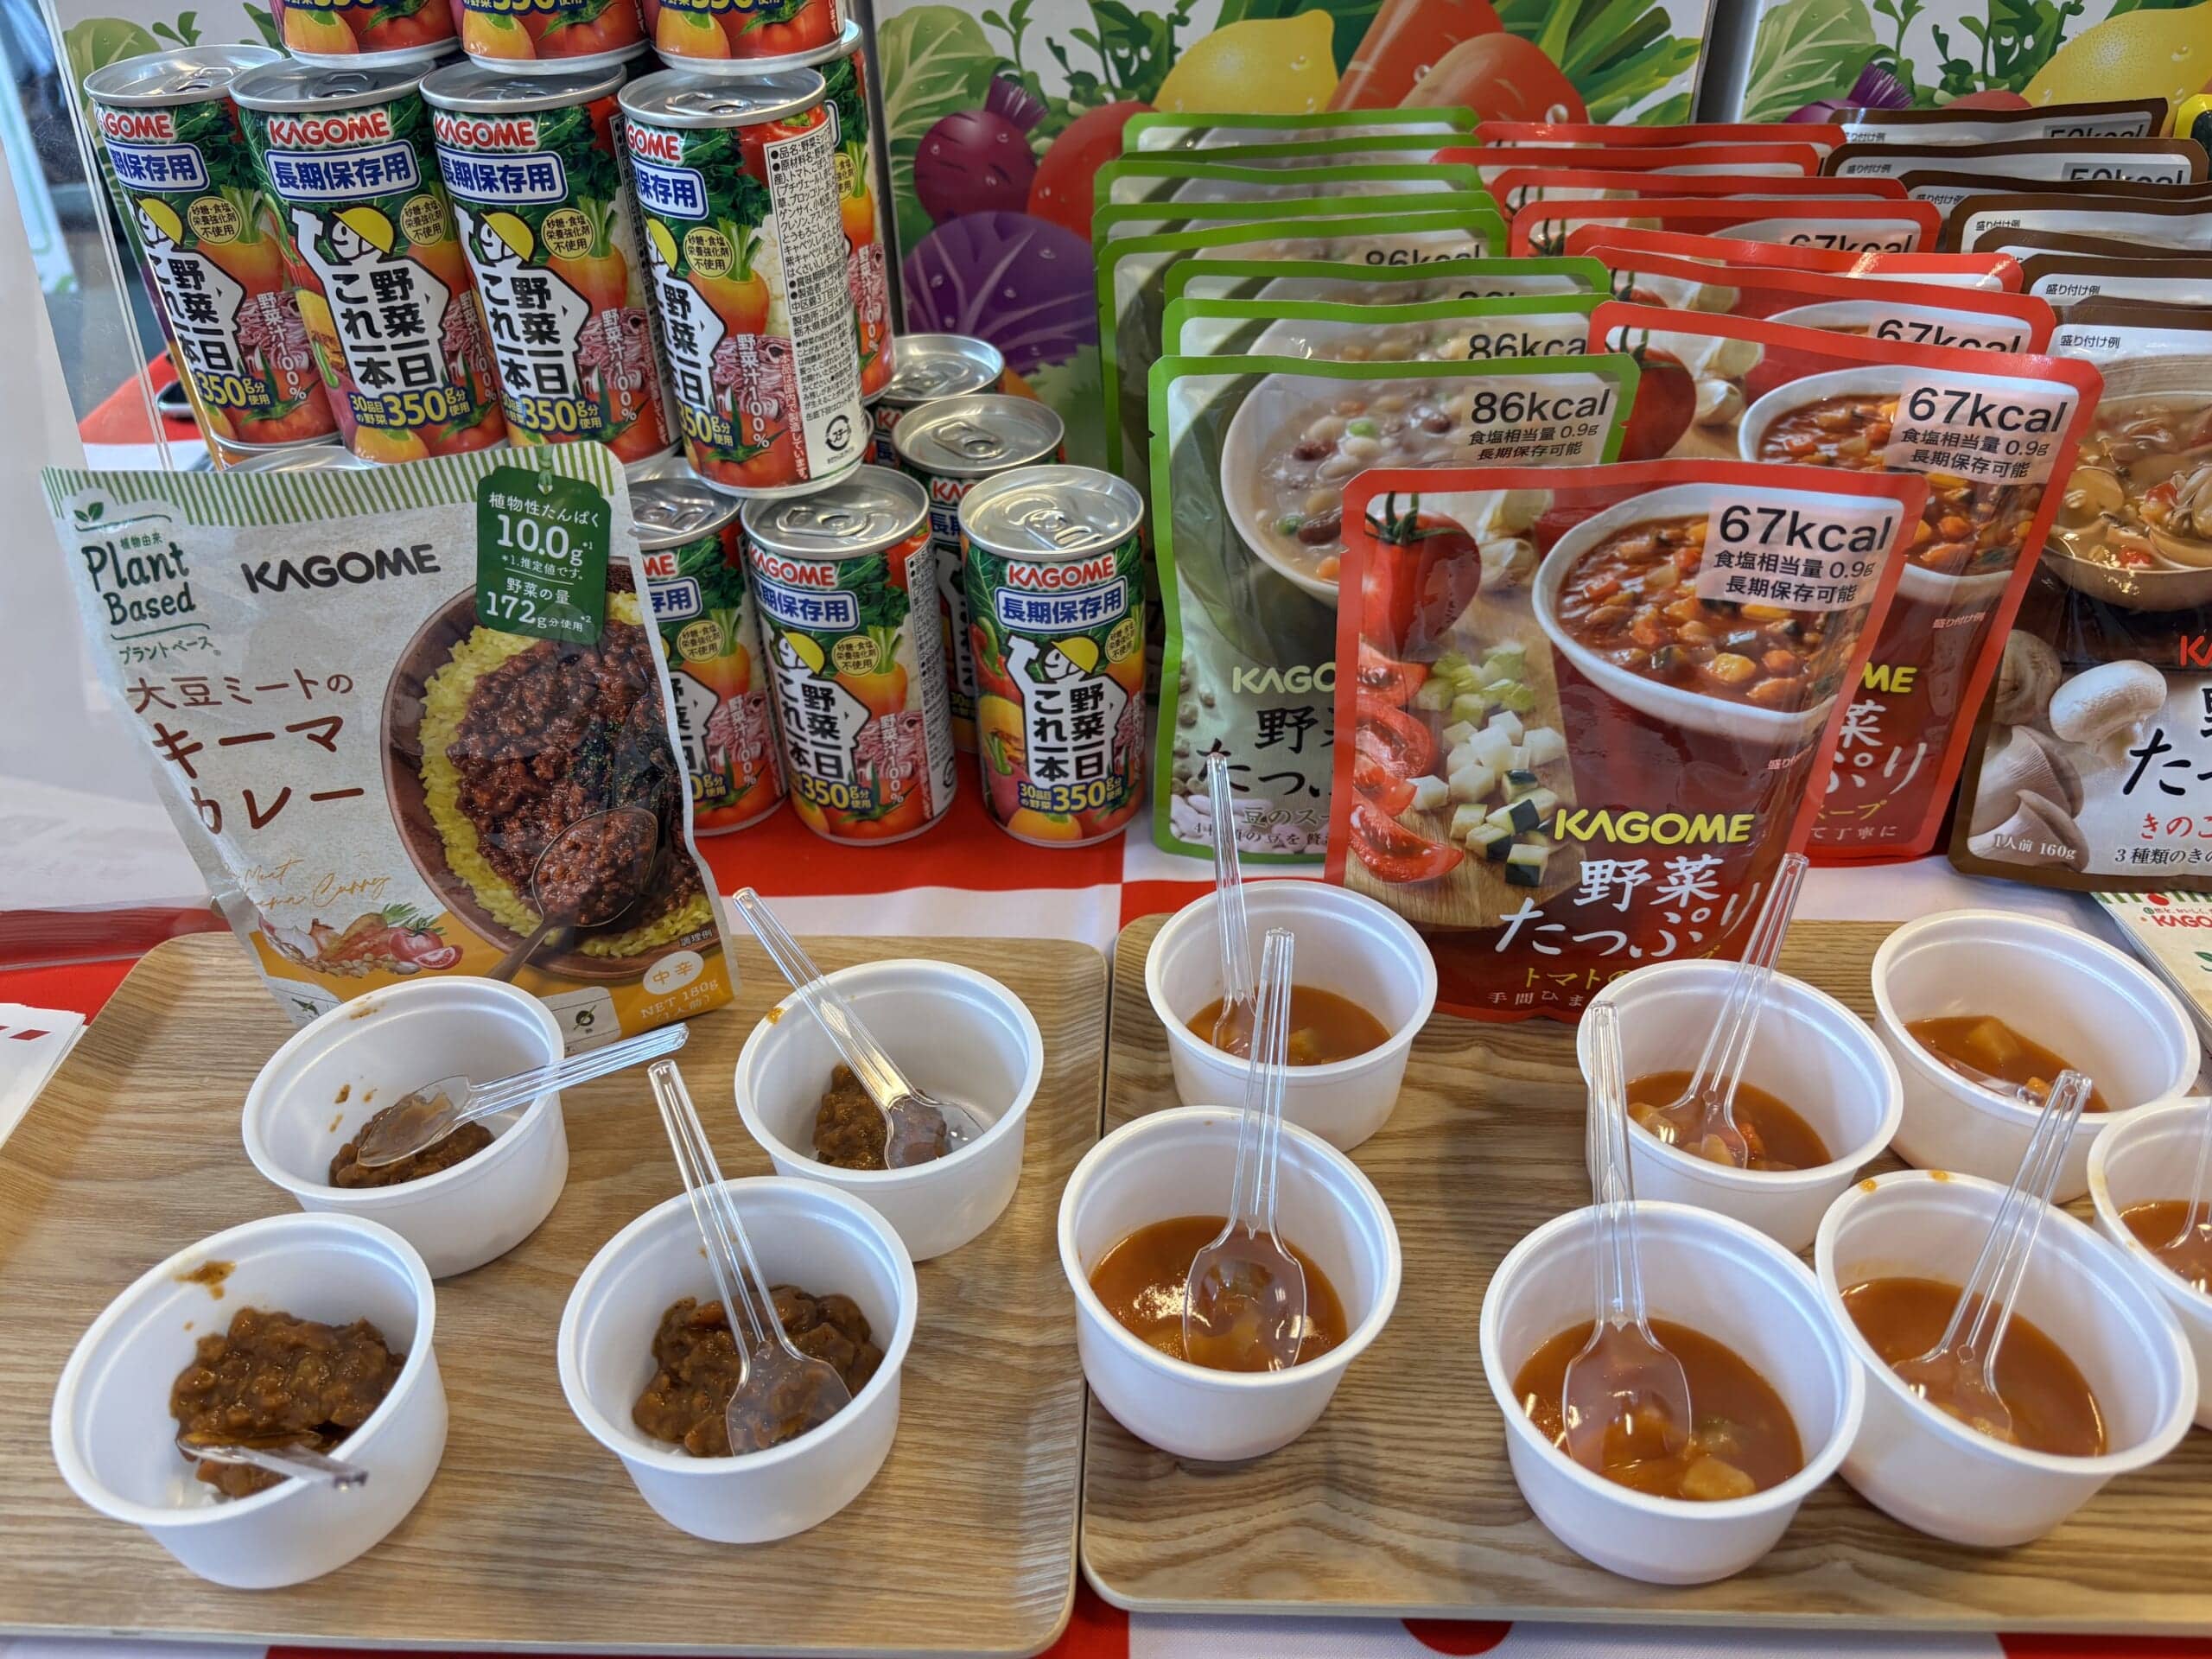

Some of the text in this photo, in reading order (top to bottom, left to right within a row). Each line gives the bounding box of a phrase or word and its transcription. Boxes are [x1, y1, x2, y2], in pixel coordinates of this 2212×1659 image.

[98, 112, 173, 138] GOME
[269, 112, 390, 145] KAGOME
[434, 116, 537, 147] KAGOME
[626, 124, 681, 162] GOME
[111, 149, 198, 181] 期保存用
[275, 154, 411, 190] 長期保存用
[442, 160, 556, 194] 長期保存用
[636, 169, 698, 208] 保存用
[553, 238, 588, 253] 不使用
[694, 259, 726, 270] 不使用
[2045, 283, 2101, 297] 盛り付け例
[168, 258, 233, 371] 野菜一日
[332, 273, 396, 390] これ一本
[369, 267, 431, 388] 野菜一日
[482, 273, 531, 390] これ一本
[511, 277, 569, 395] 野菜一日
[664, 283, 707, 407] 野菜一日
[1468, 332, 1586, 359] 86kca
[2060, 334, 2120, 350] 盛り付け例
[736, 334, 770, 448] 野菜汁100%
[1471, 388, 1611, 424] 86kcal
[1909, 387, 2068, 434] 67kcal
[1468, 423, 1599, 447] 食塩相当量 0.9g
[1477, 441, 1583, 461] 長期保存可能
[1901, 428, 2050, 457] 食塩相当量 0.9g
[1910, 448, 2031, 480] 長期保存可能
[488, 492, 600, 528] 植物性たんぱく
[120, 531, 163, 550] 植物由来
[1719, 505, 1893, 554] 67kcal
[81, 541, 189, 592] Plant
[240, 543, 442, 594] KAGOME
[1008, 556, 1115, 588] KAGOME
[1713, 549, 1876, 579] 食塩相当量 0.9g
[103, 582, 196, 626] Based
[506, 577, 570, 606] 野菜の量
[760, 582, 850, 622] 期保存用
[1726, 575, 1859, 604] 長期保存可能
[1002, 590, 1122, 624] 長期保存用
[1932, 612, 1986, 629] 盛り付け例
[119, 635, 215, 665] プラントベース
[127, 668, 354, 715] 大豆ミートの
[1232, 662, 1336, 694] KAGO
[153, 716, 343, 779] キーマ
[801, 683, 845, 779] 野菜一日
[1033, 690, 1070, 782] これ一本
[1070, 683, 1105, 779] 野菜一日
[191, 786, 365, 835] カレー
[1554, 808, 1756, 845] KAGOME
[1993, 835, 2077, 861] 1人前 160g
[1573, 853, 1725, 912] 野菜
[2151, 914, 2212, 928] KAGO
[652, 961, 693, 985] 中辛
[640, 995, 677, 1019] NET
